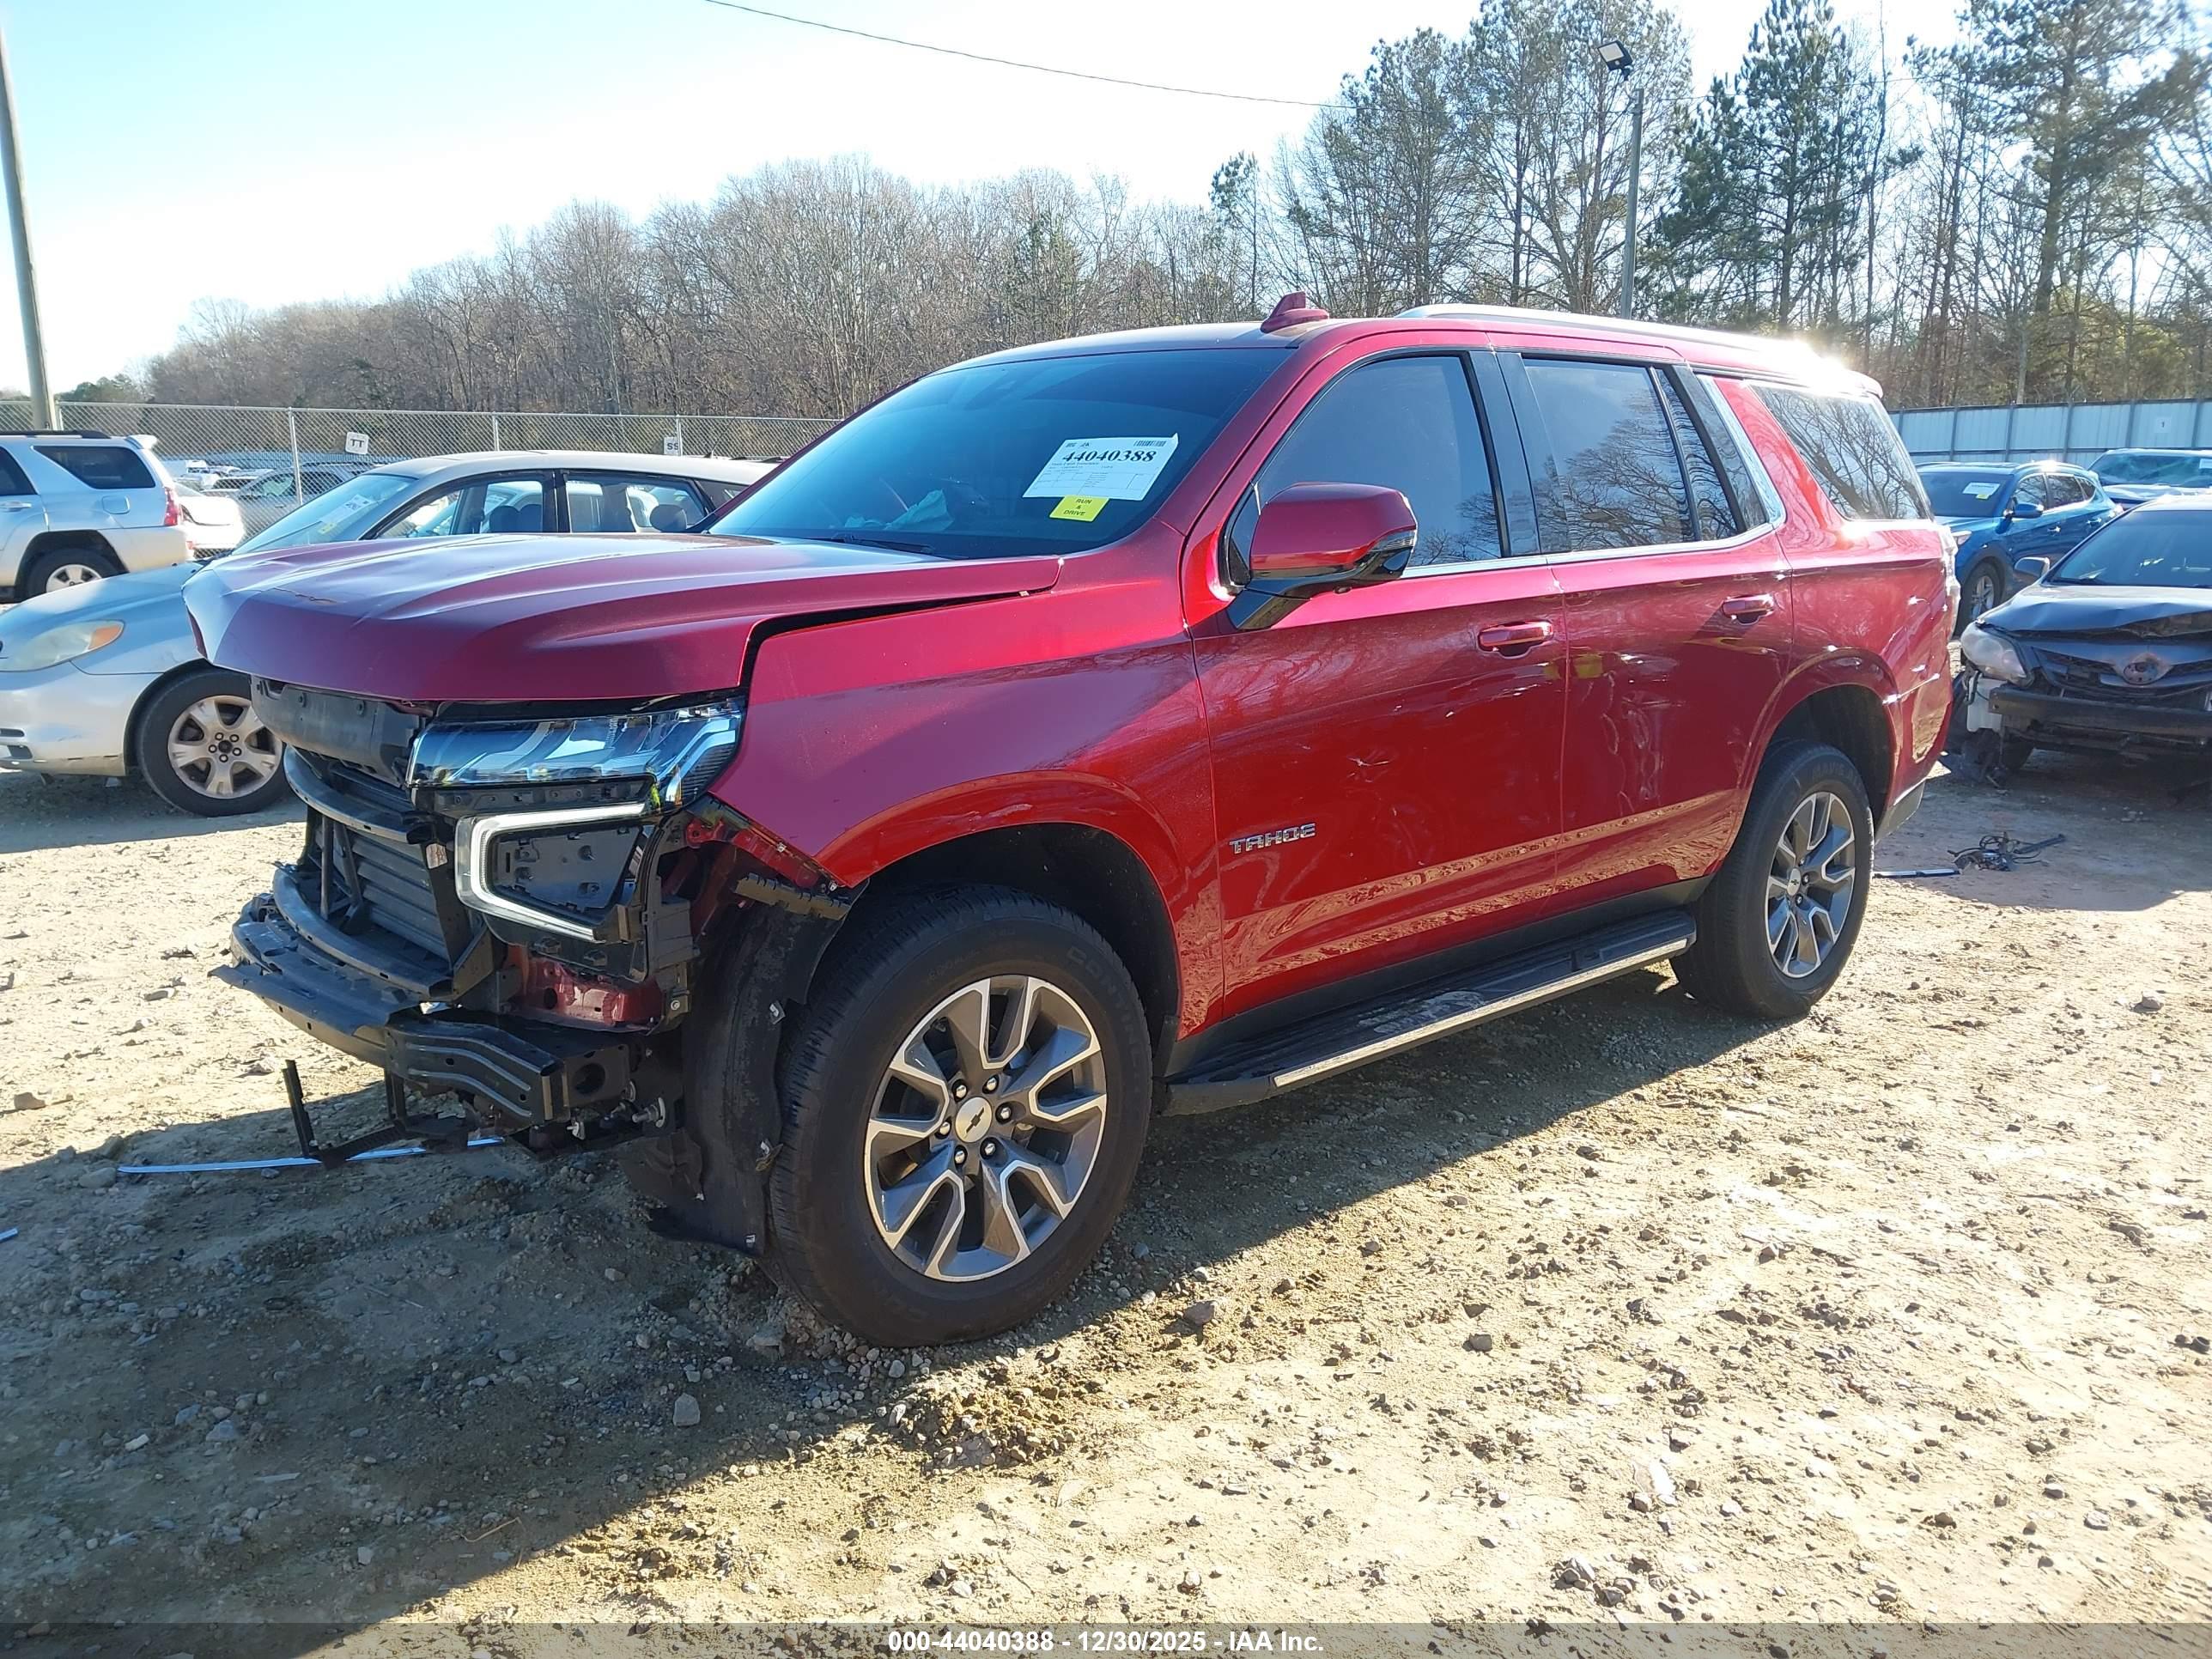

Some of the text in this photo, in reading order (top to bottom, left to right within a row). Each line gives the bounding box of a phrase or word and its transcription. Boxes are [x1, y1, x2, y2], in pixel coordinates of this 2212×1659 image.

[350, 438, 365, 447] TT
[666, 442, 679, 451] SS
[1063, 450, 1157, 462] 44040388
[1229, 823, 1316, 854] TAHOE
